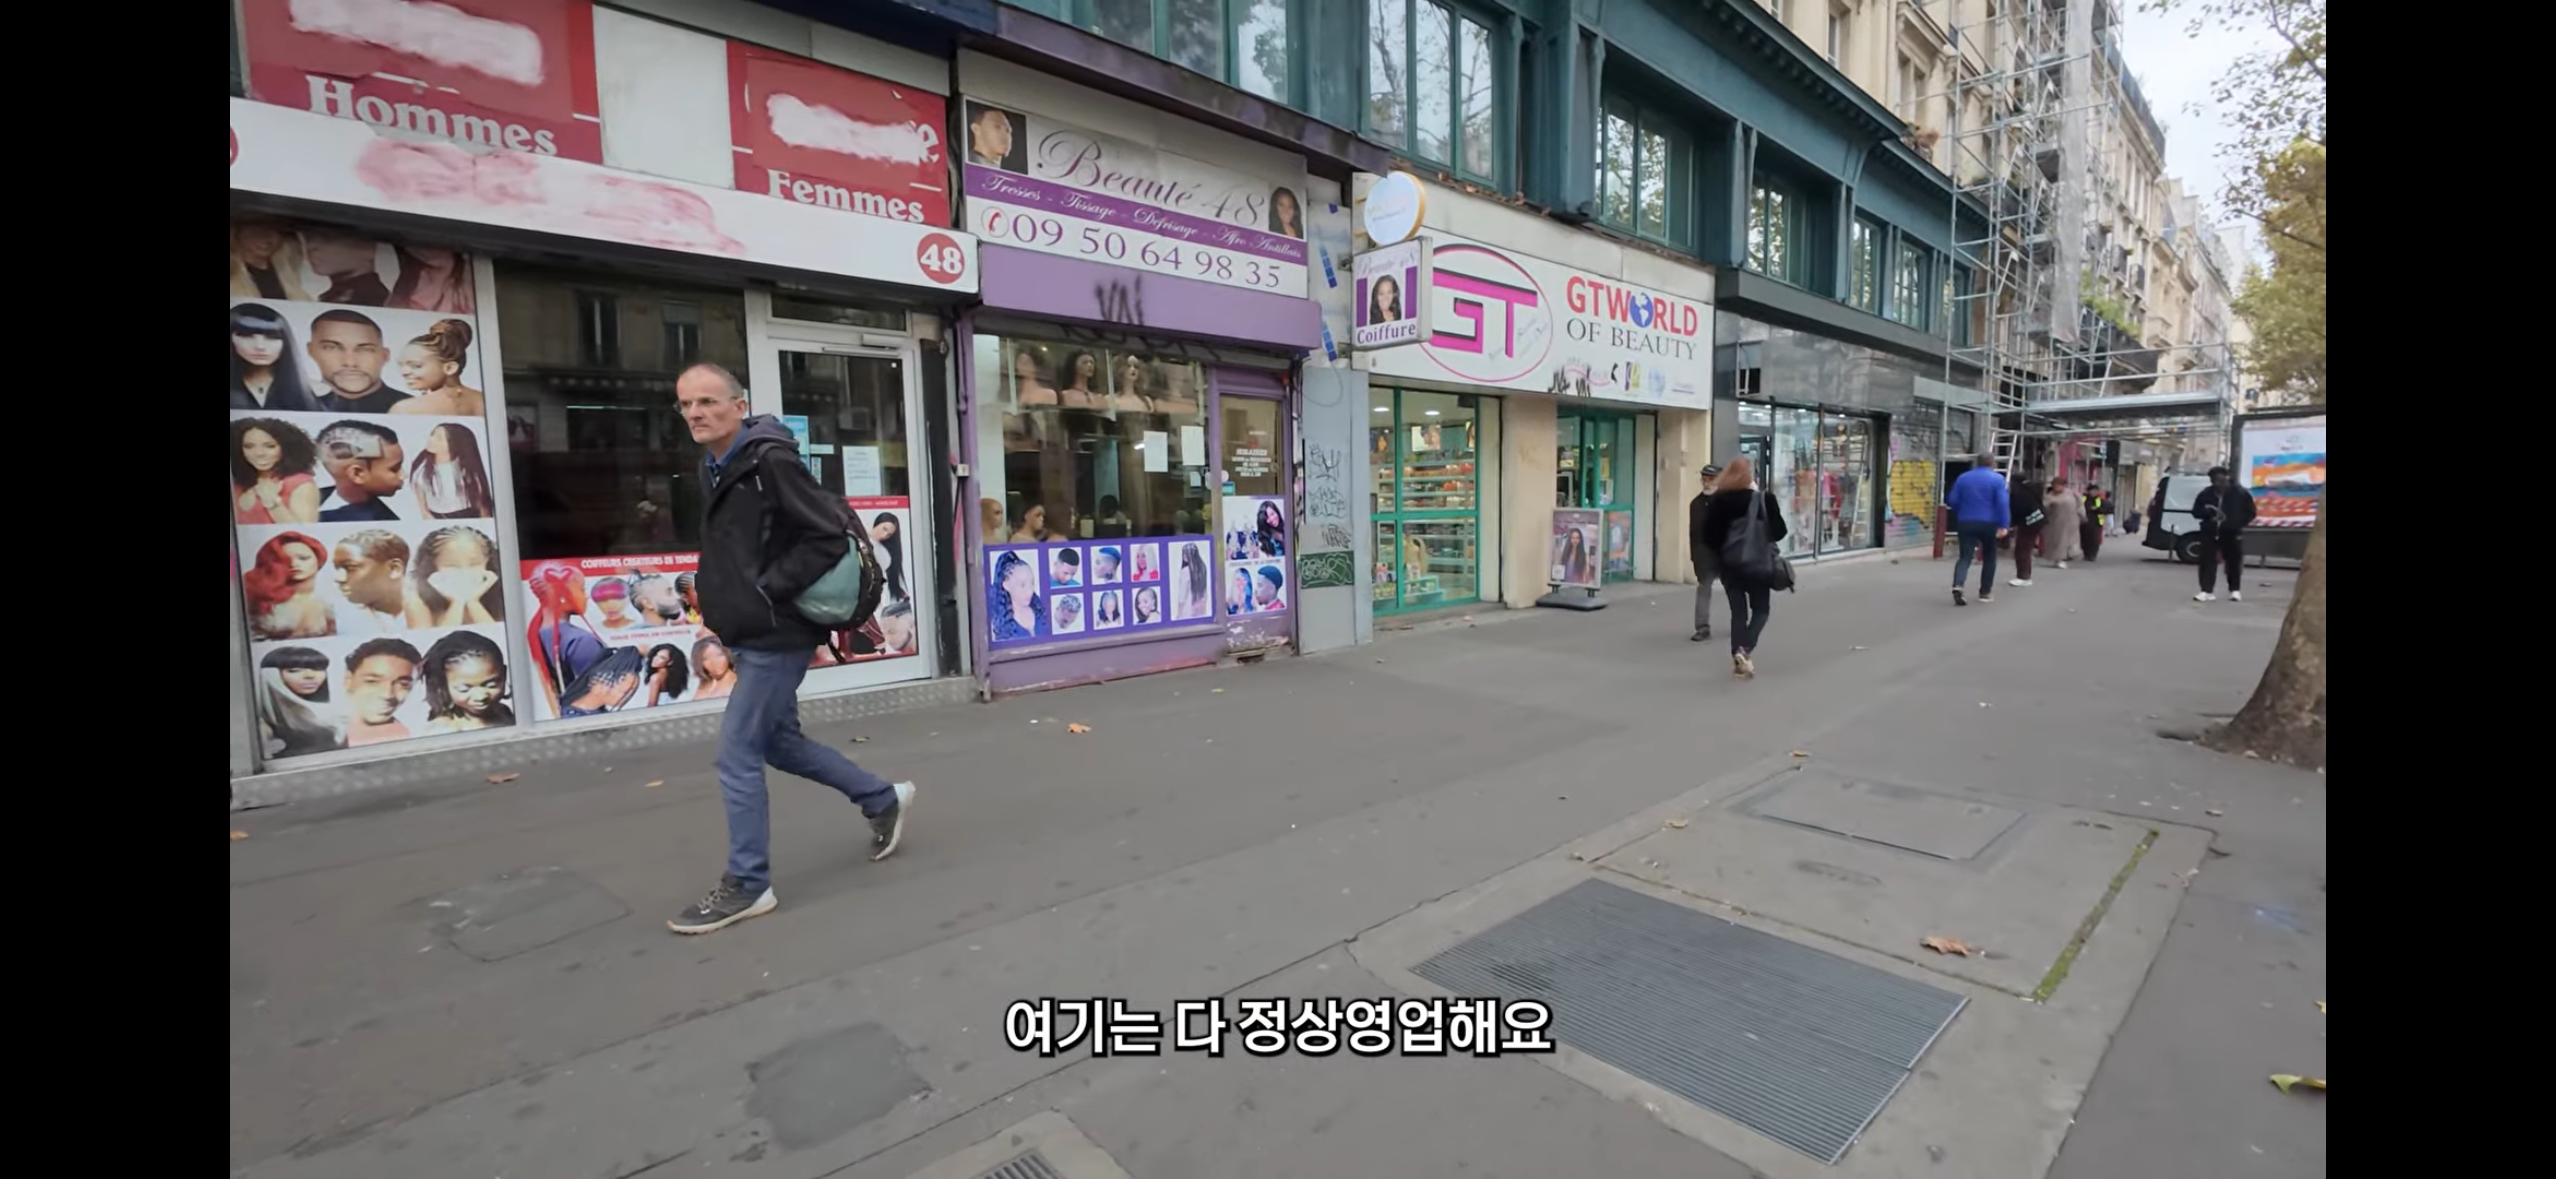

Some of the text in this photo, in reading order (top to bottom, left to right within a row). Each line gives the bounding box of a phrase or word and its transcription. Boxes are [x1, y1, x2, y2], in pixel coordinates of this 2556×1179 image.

[305, 75, 557, 156] Hommes
[767, 169, 924, 224] Femmes
[1037, 130, 1265, 225] Beauté 48
[982, 173, 1040, 201] Tresses
[1061, 191, 1117, 220] Tissage
[1212, 225, 1247, 247] Afro
[919, 243, 963, 275] 48
[1012, 213, 1281, 288] 09 50 64 98 35
[1356, 322, 1417, 345] Coiffure
[1567, 318, 1601, 342] OF
[1611, 326, 1697, 360] BEAUTY
